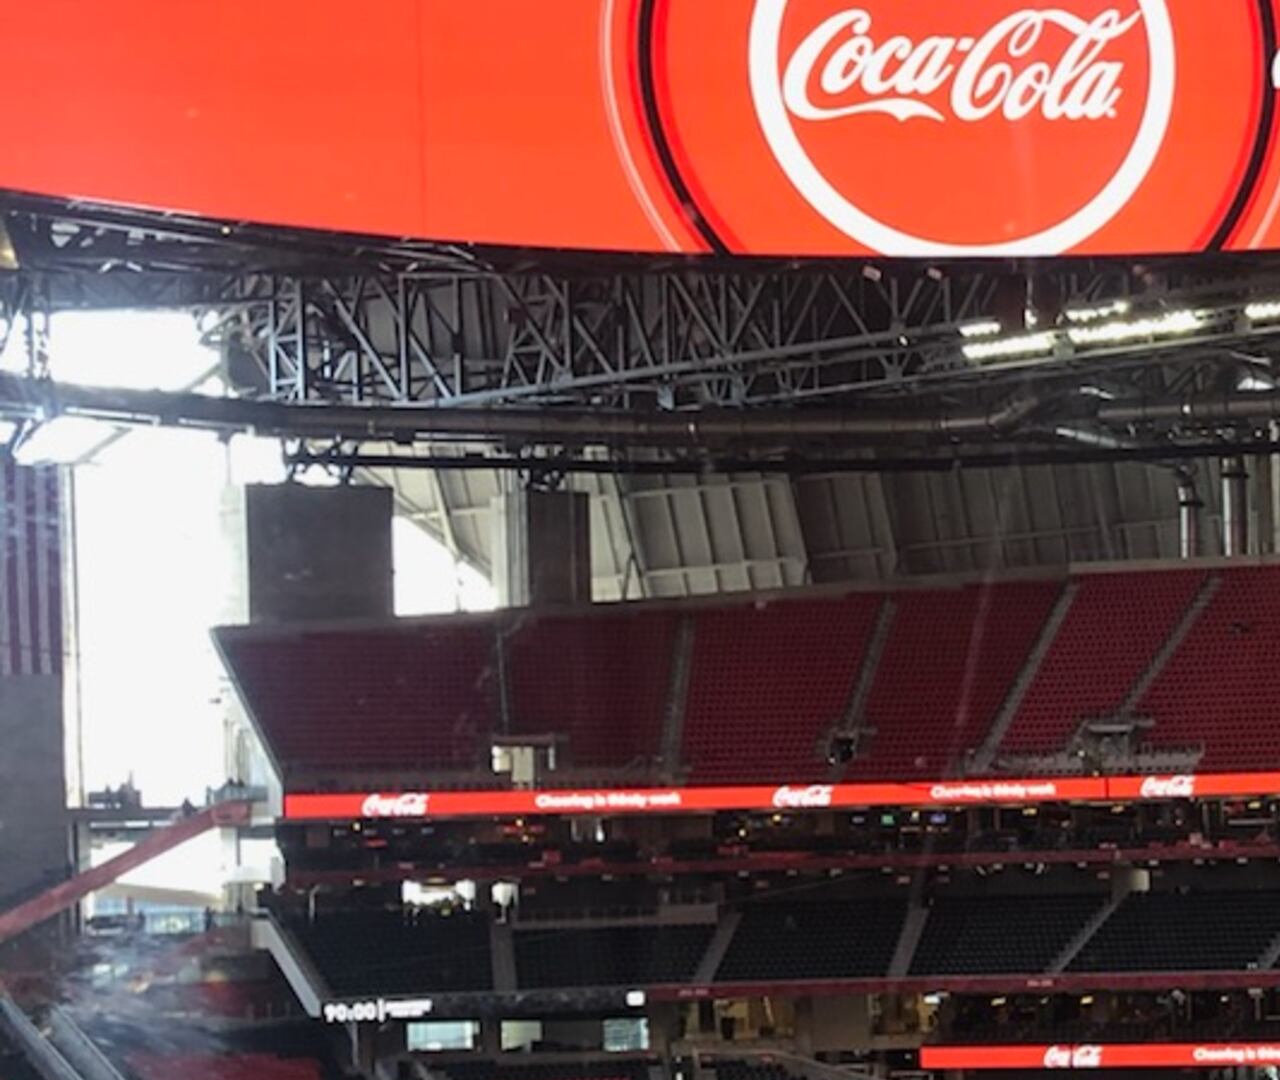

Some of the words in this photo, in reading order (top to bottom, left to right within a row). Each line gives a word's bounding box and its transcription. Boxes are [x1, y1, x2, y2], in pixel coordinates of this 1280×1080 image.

[783, 9, 1141, 121] Coca-Cola
[773, 786, 832, 807] Coca-Cola
[1141, 776, 1194, 797] Coca-Cola
[362, 794, 429, 816] Coca-Cola
[324, 1002, 377, 1021] 90:00
[1044, 1046, 1101, 1067] Coca-Cola
